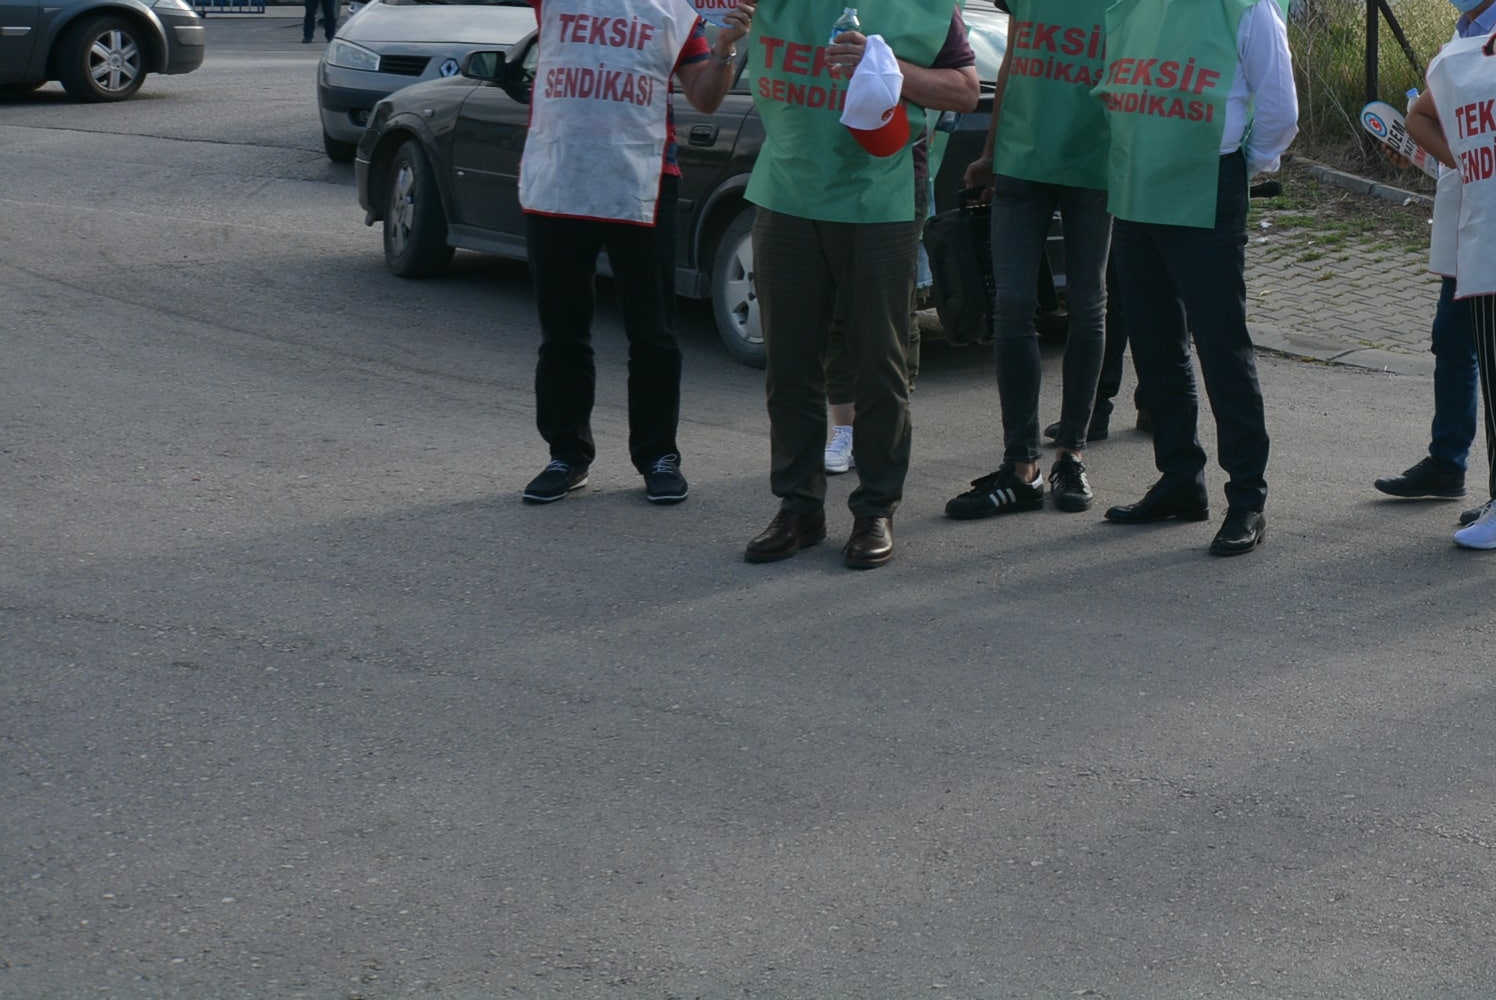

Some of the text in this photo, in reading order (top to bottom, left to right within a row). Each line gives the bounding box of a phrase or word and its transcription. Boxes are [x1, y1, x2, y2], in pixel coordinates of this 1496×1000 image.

[559, 13, 655, 50] TEKSİF
[545, 62, 653, 107] SENDİKASI
[758, 76, 848, 112] SENDİ
[1105, 57, 1221, 95] TEKSİF
